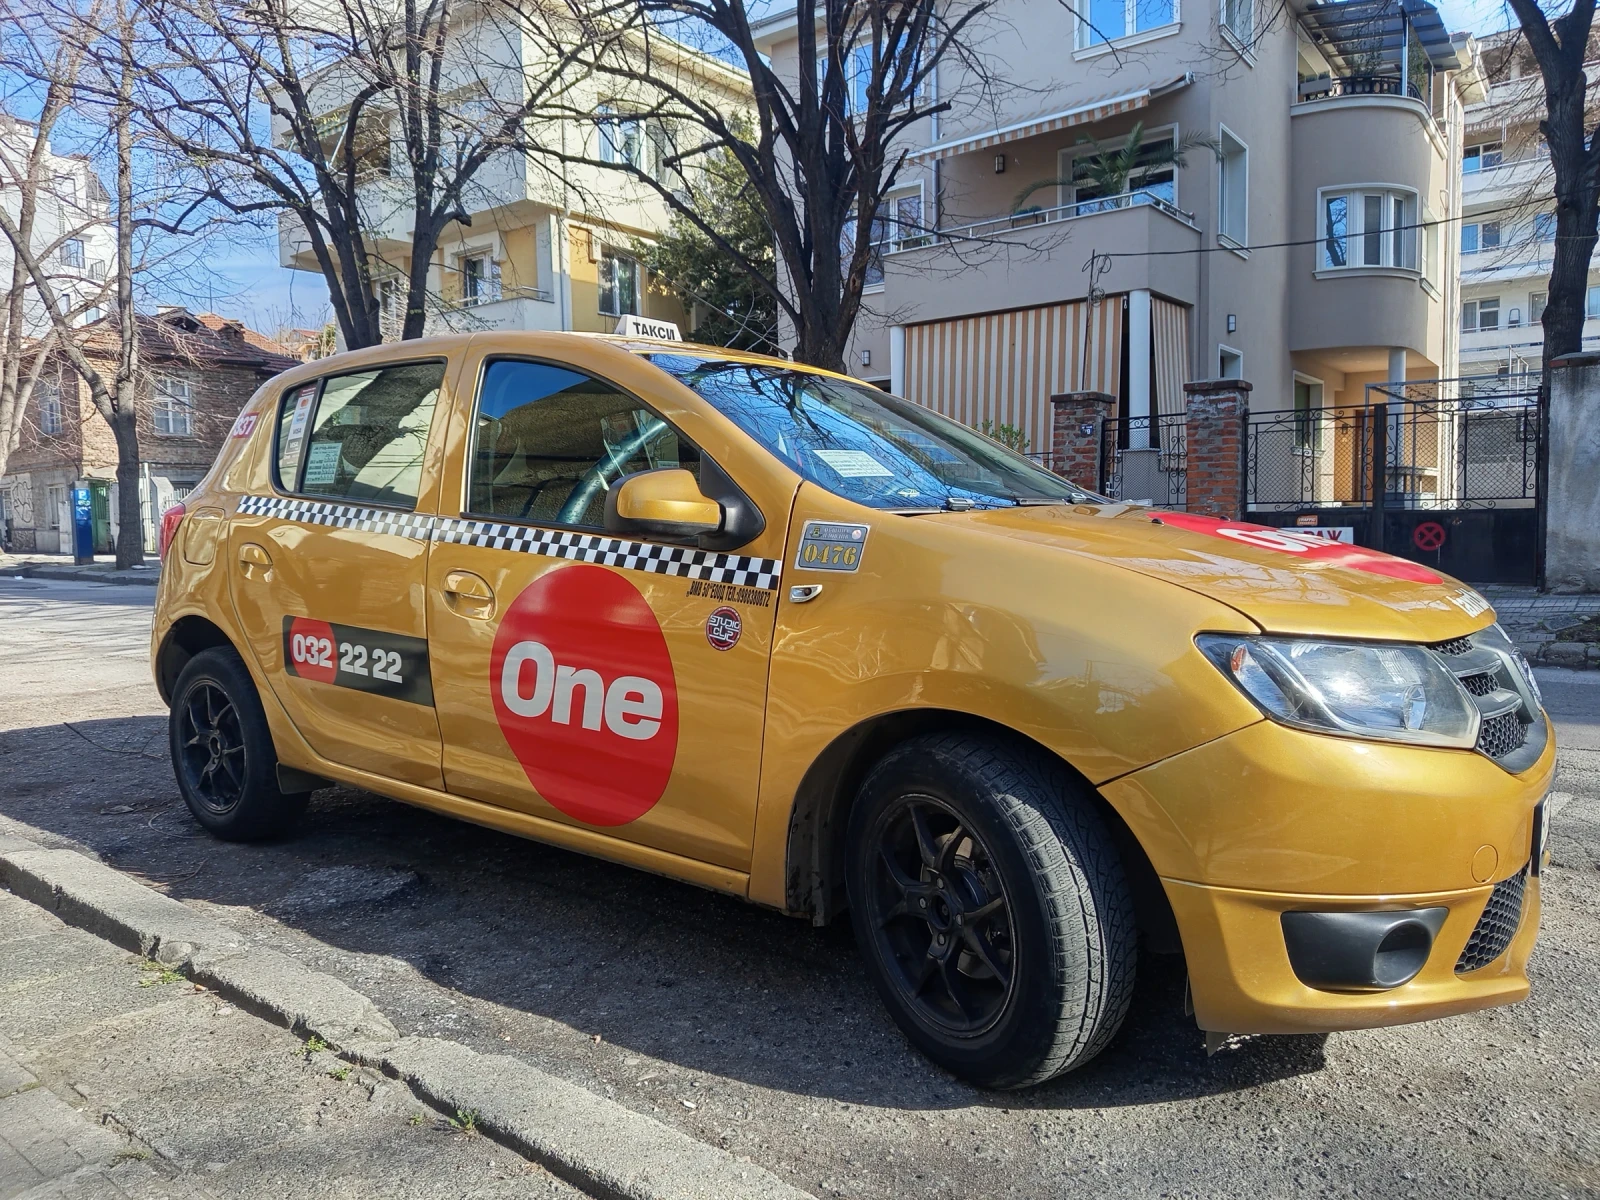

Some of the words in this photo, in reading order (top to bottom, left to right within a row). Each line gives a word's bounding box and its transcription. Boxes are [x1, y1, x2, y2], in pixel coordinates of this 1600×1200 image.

[632, 322, 676, 340] ТАКСИ
[804, 544, 857, 565] 0476
[292, 633, 333, 668] 032
[339, 642, 369, 676] 22
[372, 649, 403, 684] 22
[501, 640, 664, 741] One
